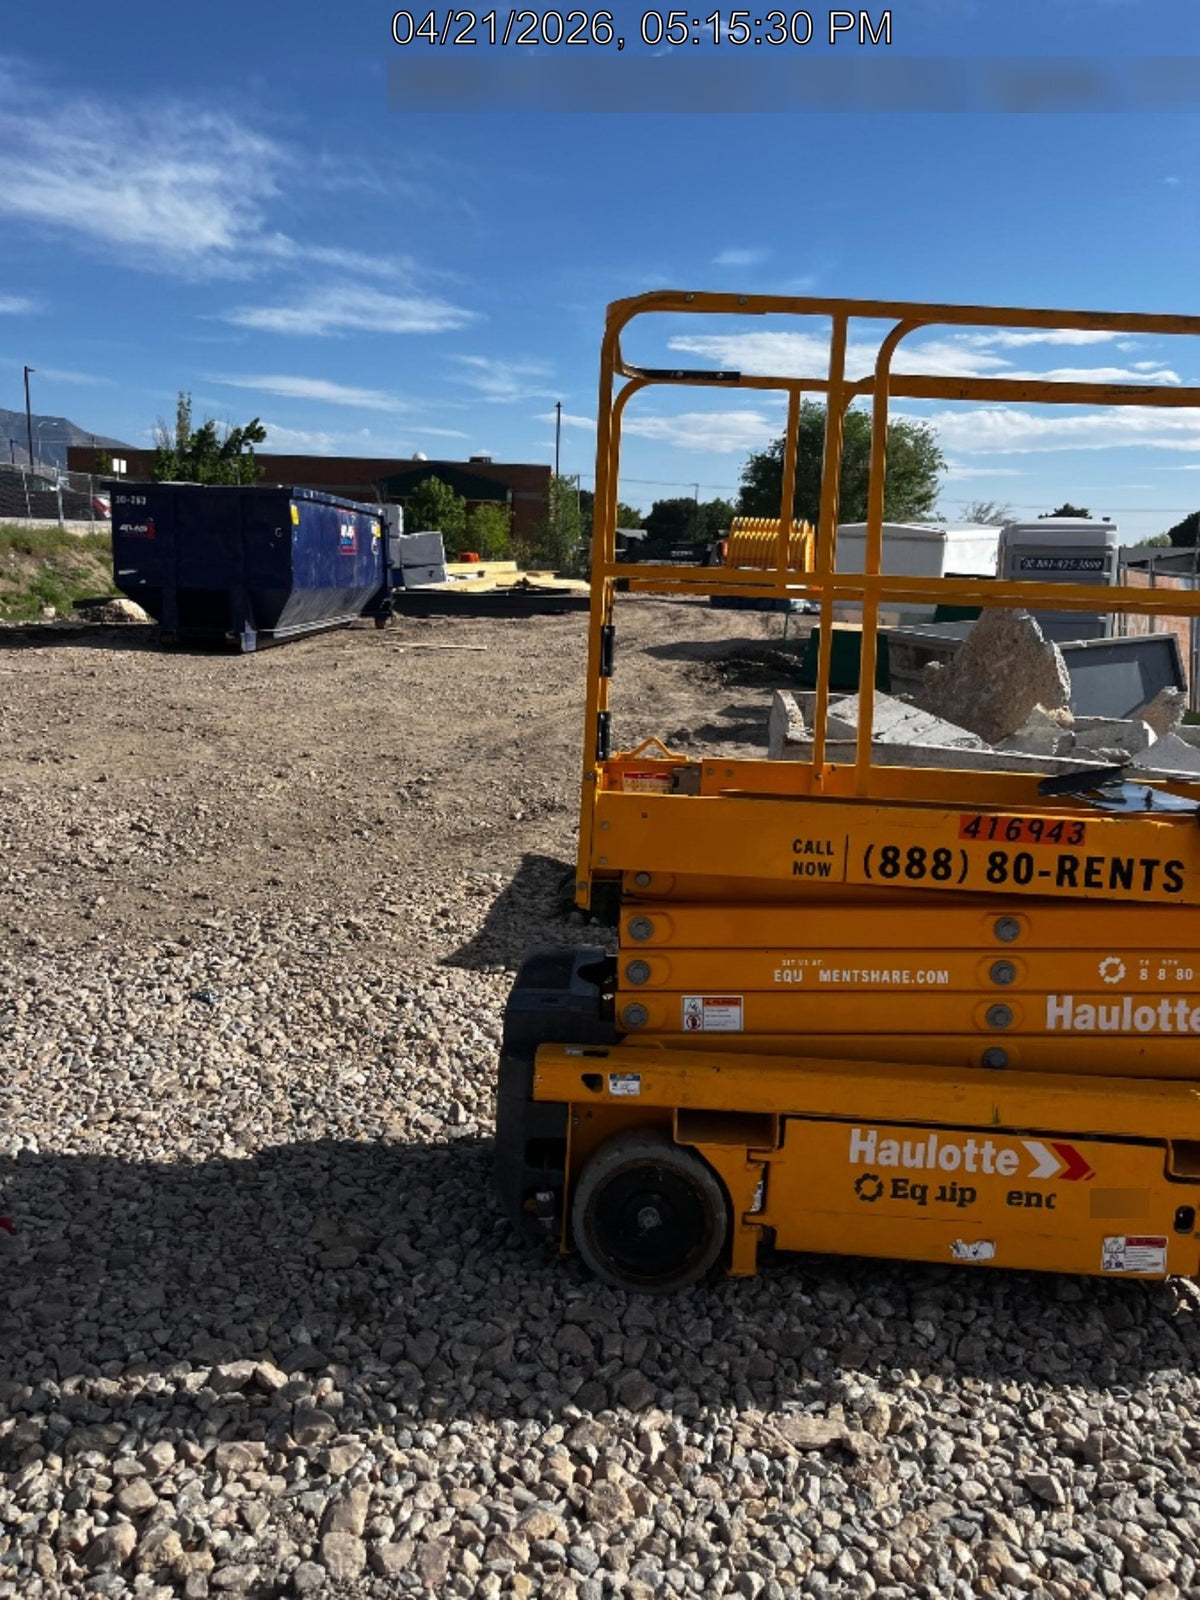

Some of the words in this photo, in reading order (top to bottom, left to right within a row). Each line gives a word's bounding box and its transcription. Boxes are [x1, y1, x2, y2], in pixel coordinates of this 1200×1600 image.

[963, 816, 1086, 845] 416943
[792, 838, 835, 856] CALL
[792, 861, 832, 877] NOW
[863, 844, 968, 884] (888)
[986, 851, 1185, 893] 80-RENTS
[849, 1128, 1020, 1176] Haulotte
